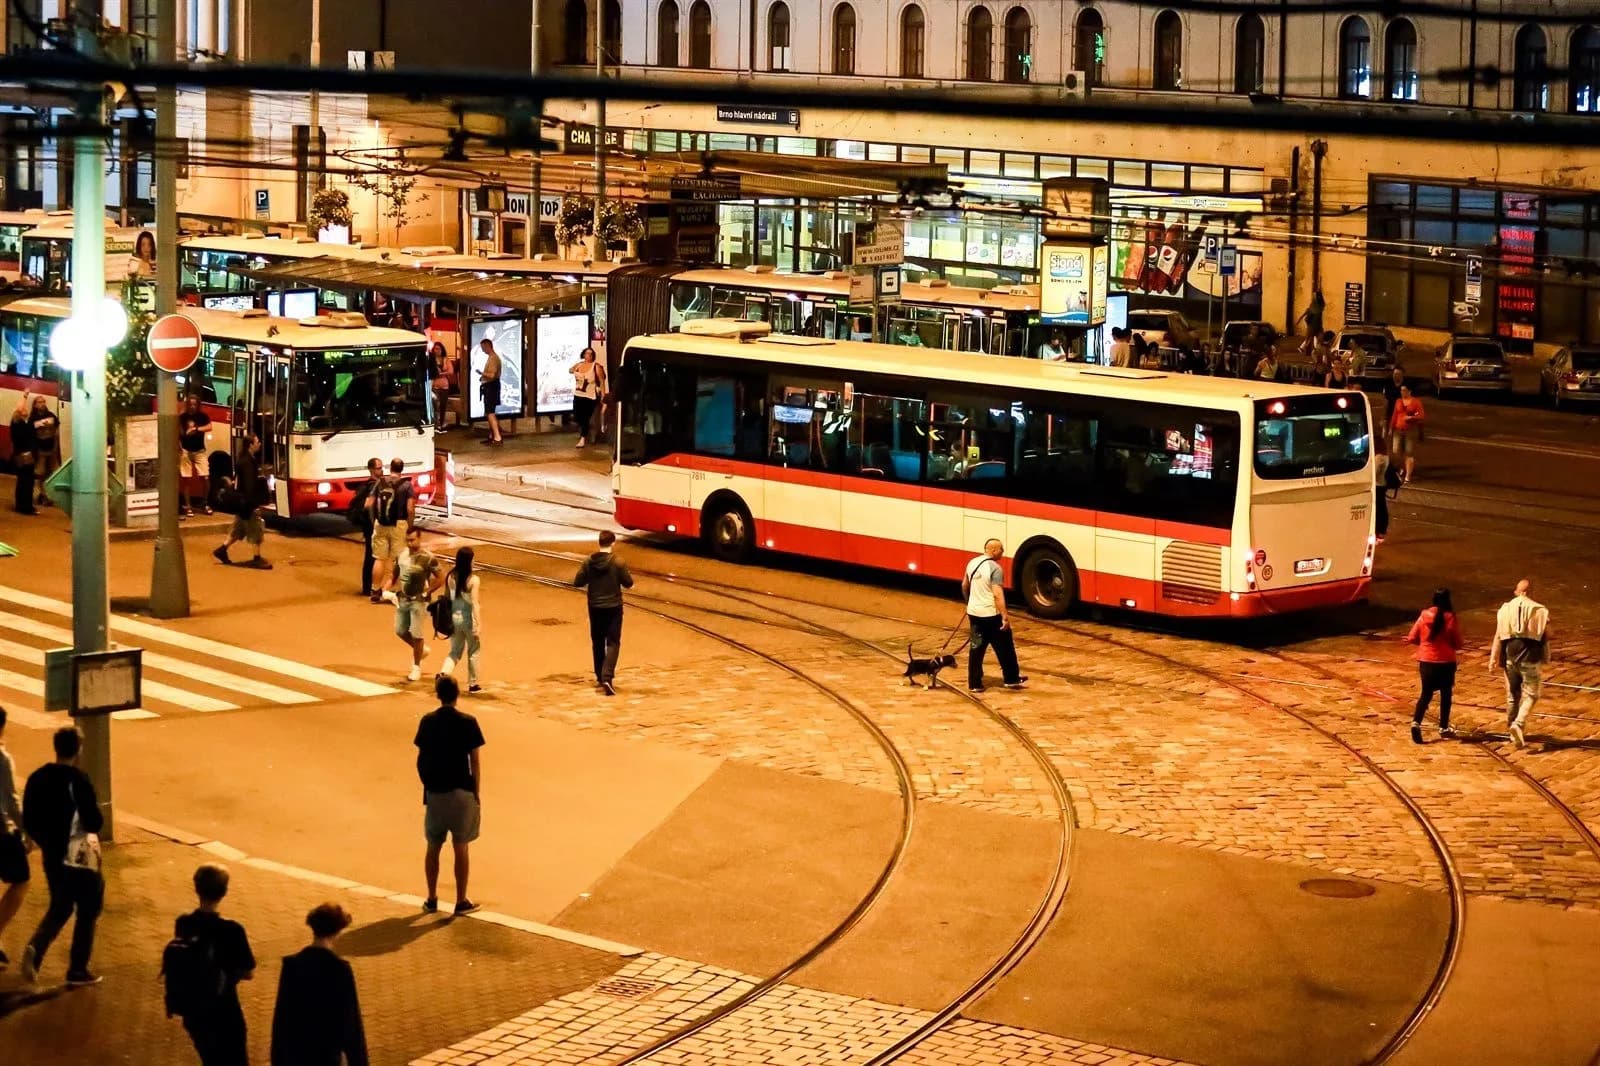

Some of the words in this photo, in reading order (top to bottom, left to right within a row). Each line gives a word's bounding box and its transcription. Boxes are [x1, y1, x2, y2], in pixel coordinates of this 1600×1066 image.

[719, 110, 733, 119] Brno
[734, 110, 753, 119] hlavní
[754, 111, 777, 121] nádraží
[571, 129, 618, 145] CHAGE
[258, 192, 266, 205] P
[540, 200, 559, 217] TOP
[1207, 238, 1215, 253] P
[691, 471, 706, 481] 7811
[1350, 509, 1366, 521] 7811
